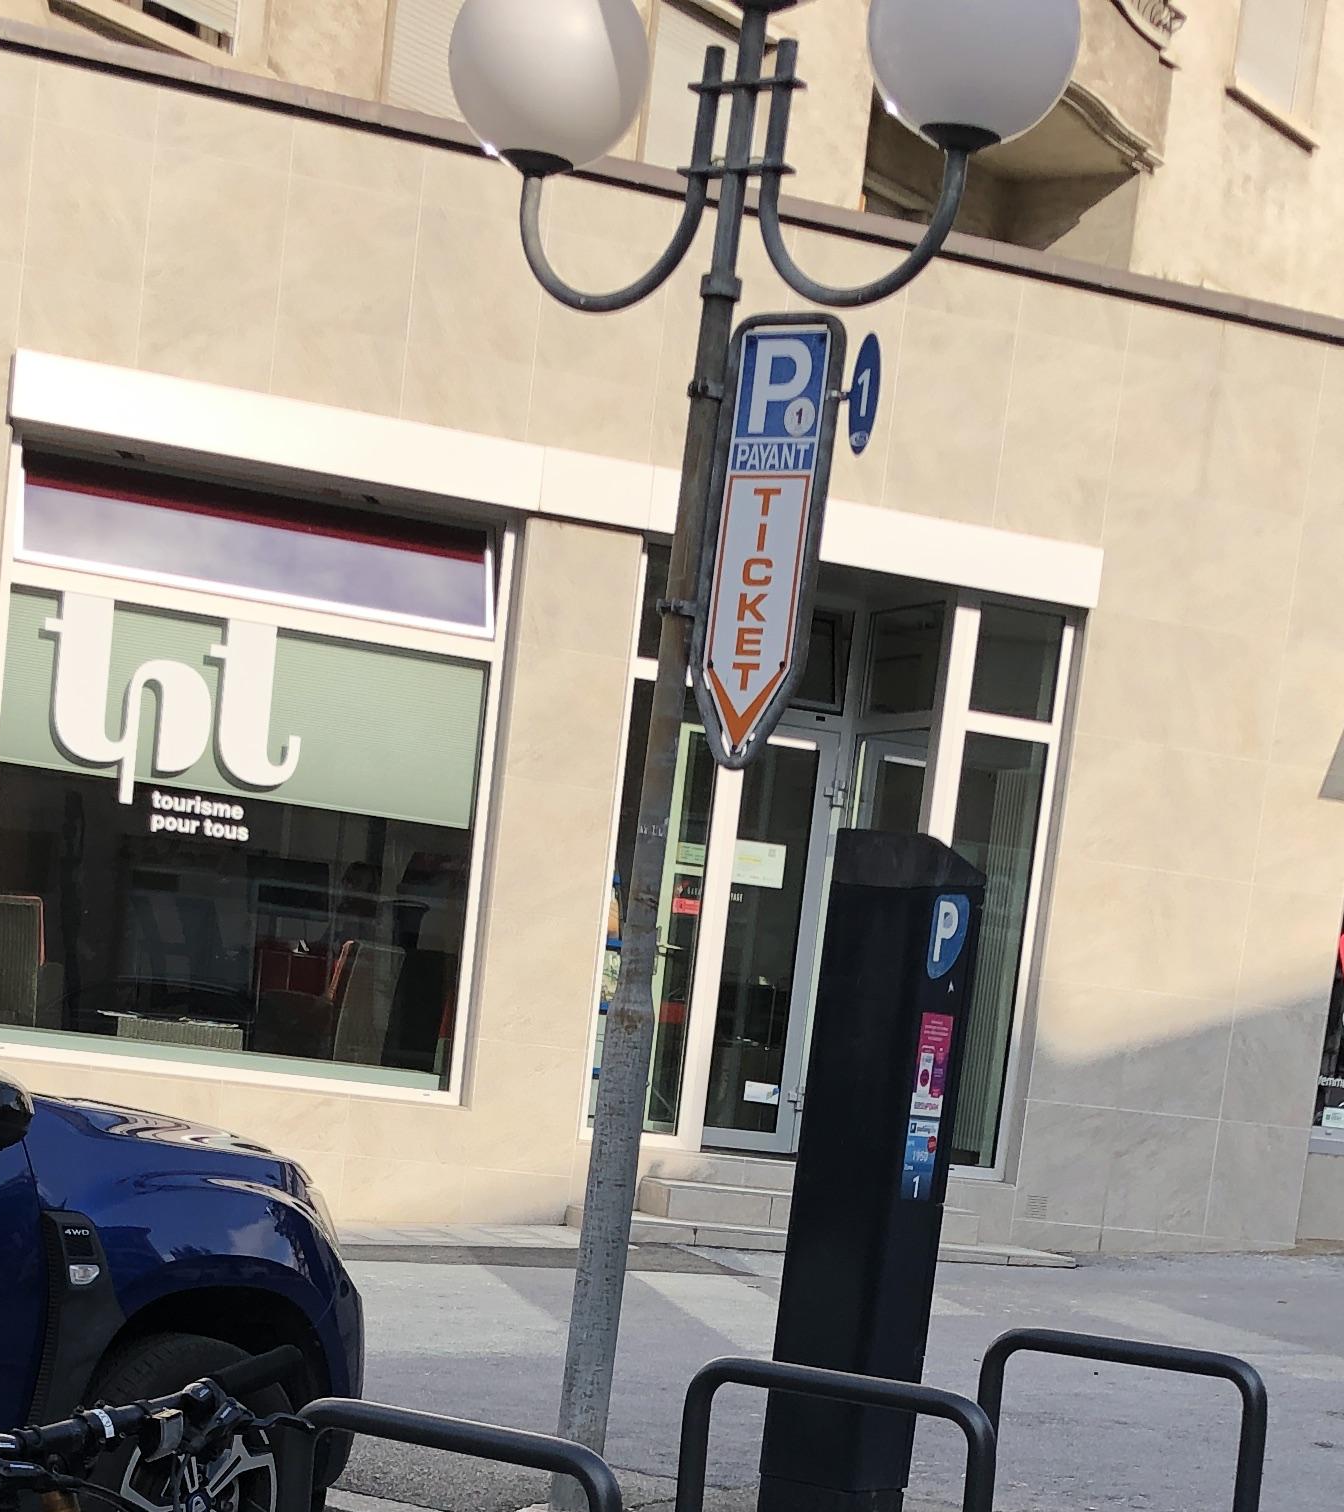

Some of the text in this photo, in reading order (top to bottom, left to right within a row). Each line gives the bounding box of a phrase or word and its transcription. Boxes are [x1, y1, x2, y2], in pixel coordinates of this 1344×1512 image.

[748, 338, 813, 435] P
[857, 368, 871, 418] 1
[795, 407, 804, 426] 1
[735, 441, 810, 471] PAYANT
[732, 487, 782, 692] TICKET
[151, 790, 244, 821] tourisme
[150, 814, 250, 842] pour tous
[932, 899, 960, 963] P
[911, 1175, 921, 1199] 1
[64, 1228, 90, 1237] 4WD
